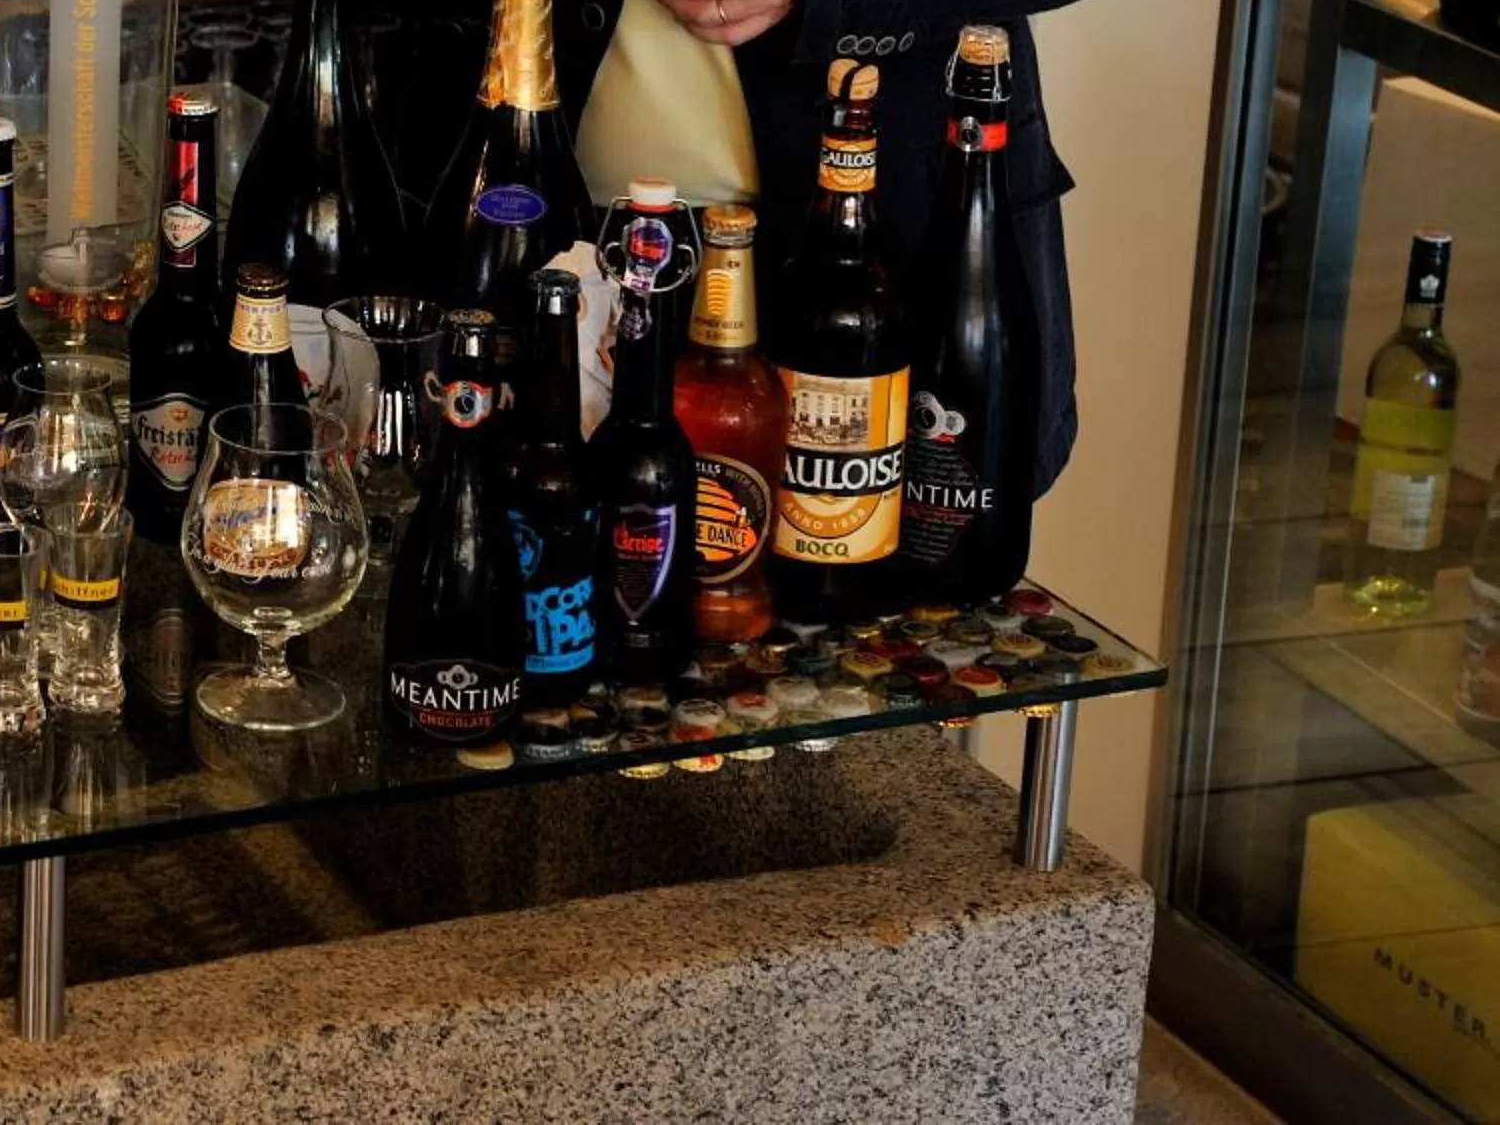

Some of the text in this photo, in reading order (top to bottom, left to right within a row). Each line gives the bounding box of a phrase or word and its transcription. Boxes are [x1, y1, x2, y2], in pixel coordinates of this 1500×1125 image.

[784, 448, 903, 490] AULOISE
[906, 480, 995, 509] NTIME
[794, 538, 850, 558] BOCQ
[525, 577, 594, 621] DCOR
[535, 610, 596, 656] IPA
[391, 671, 521, 711] MEANTIME
[1373, 946, 1486, 1039] MUSTER
